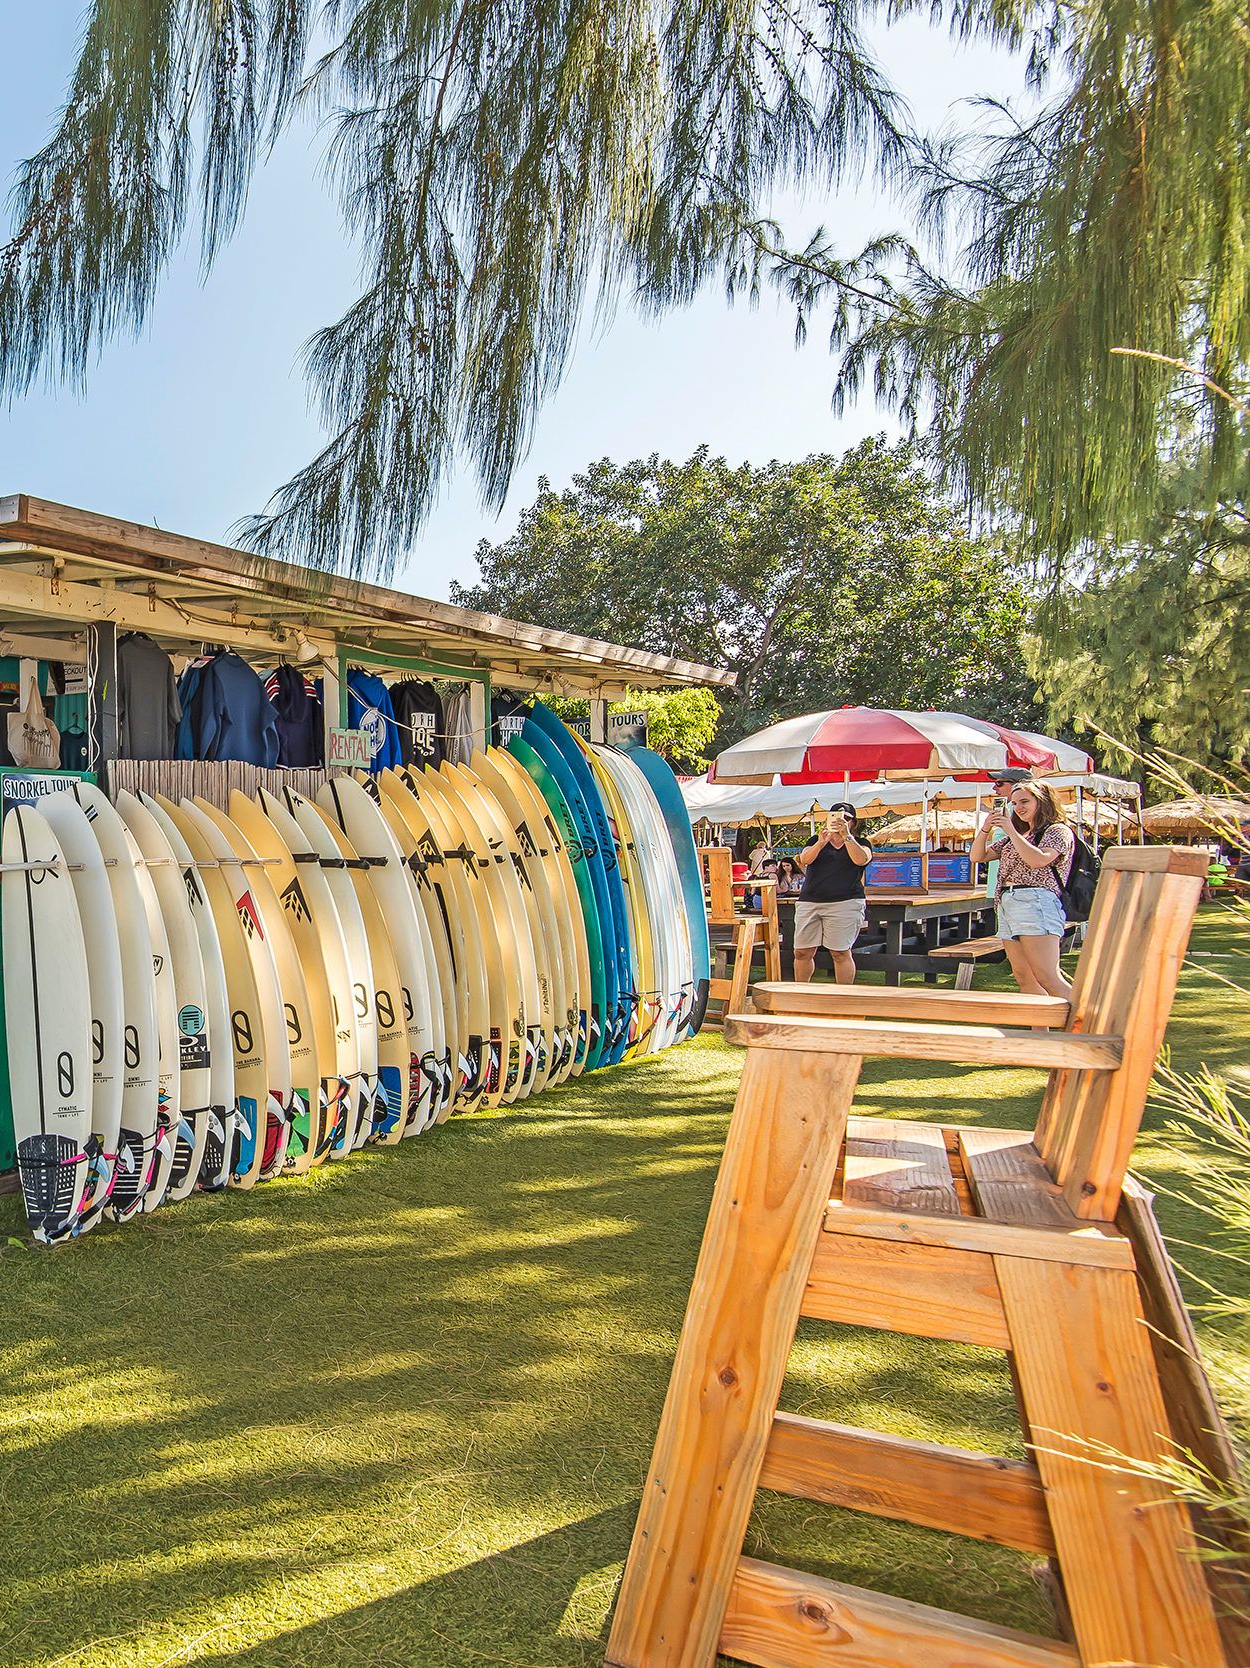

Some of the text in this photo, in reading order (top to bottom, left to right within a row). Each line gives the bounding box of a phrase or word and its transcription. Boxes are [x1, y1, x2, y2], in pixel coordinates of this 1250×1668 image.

[610, 713, 645, 727] TOURS
[330, 732, 371, 762] RENTAL
[3, 779, 50, 800] SNORKEL
